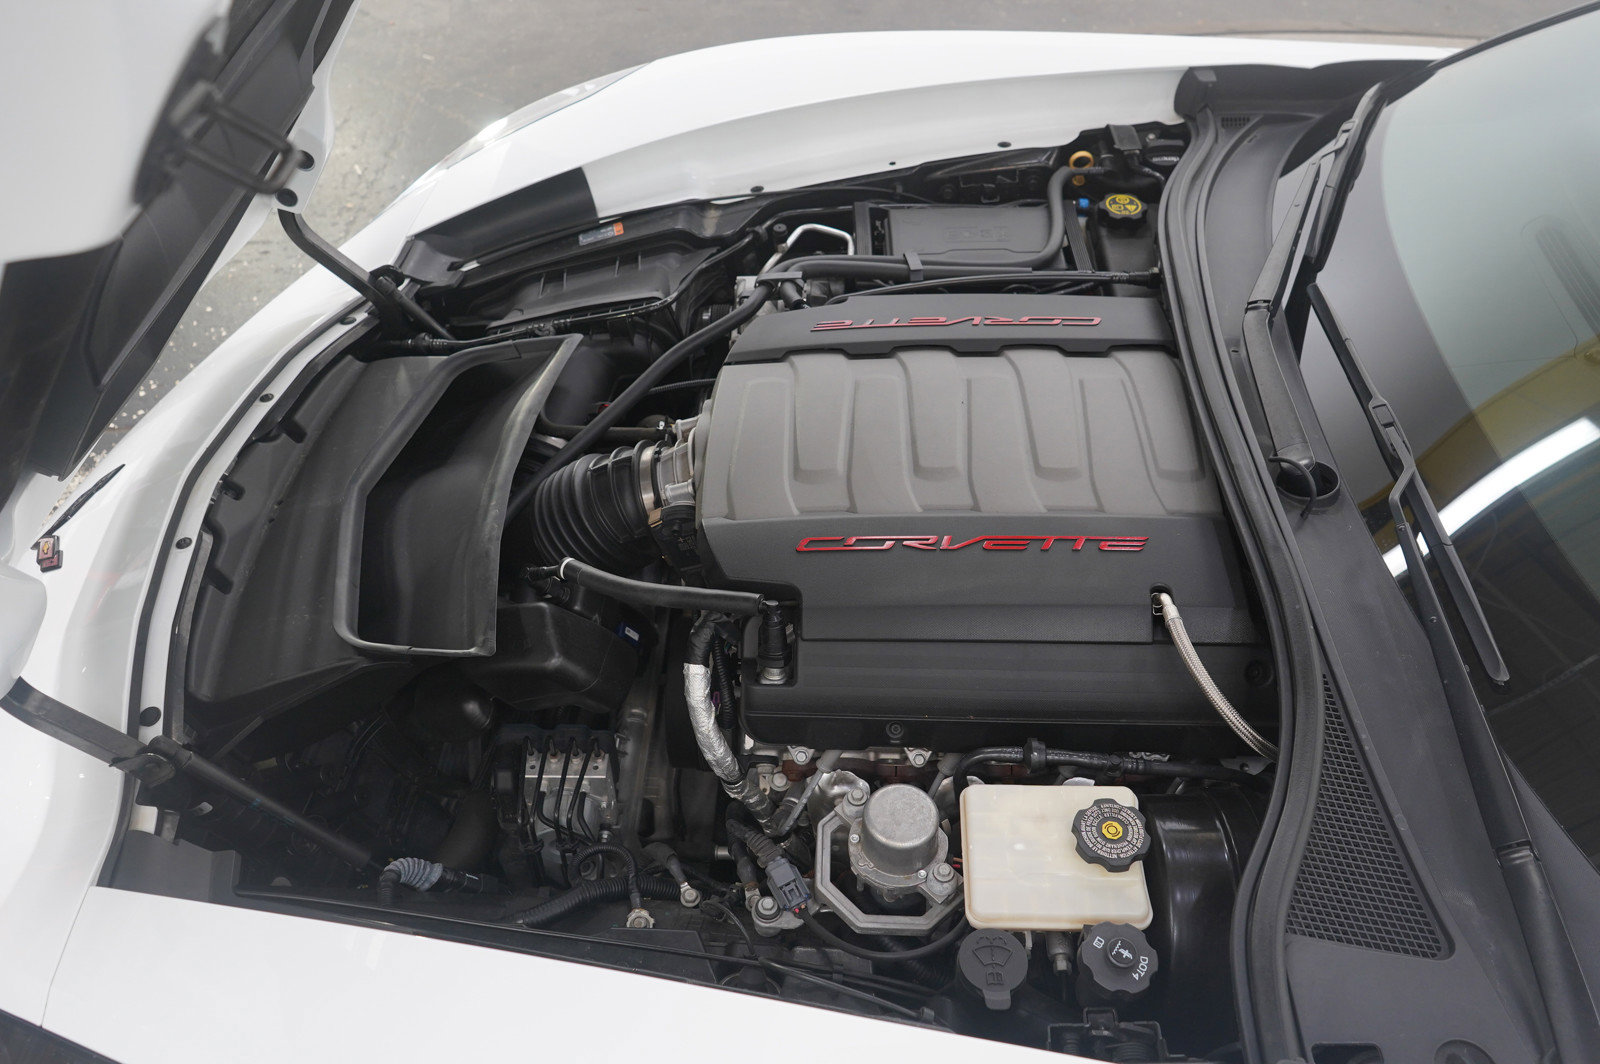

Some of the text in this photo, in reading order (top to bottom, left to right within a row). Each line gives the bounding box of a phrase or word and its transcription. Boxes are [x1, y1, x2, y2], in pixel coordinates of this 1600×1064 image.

[810, 316, 1102, 332] CORVETTE
[796, 535, 1149, 551] CORVETTE
[1132, 956, 1149, 980] DOT4
